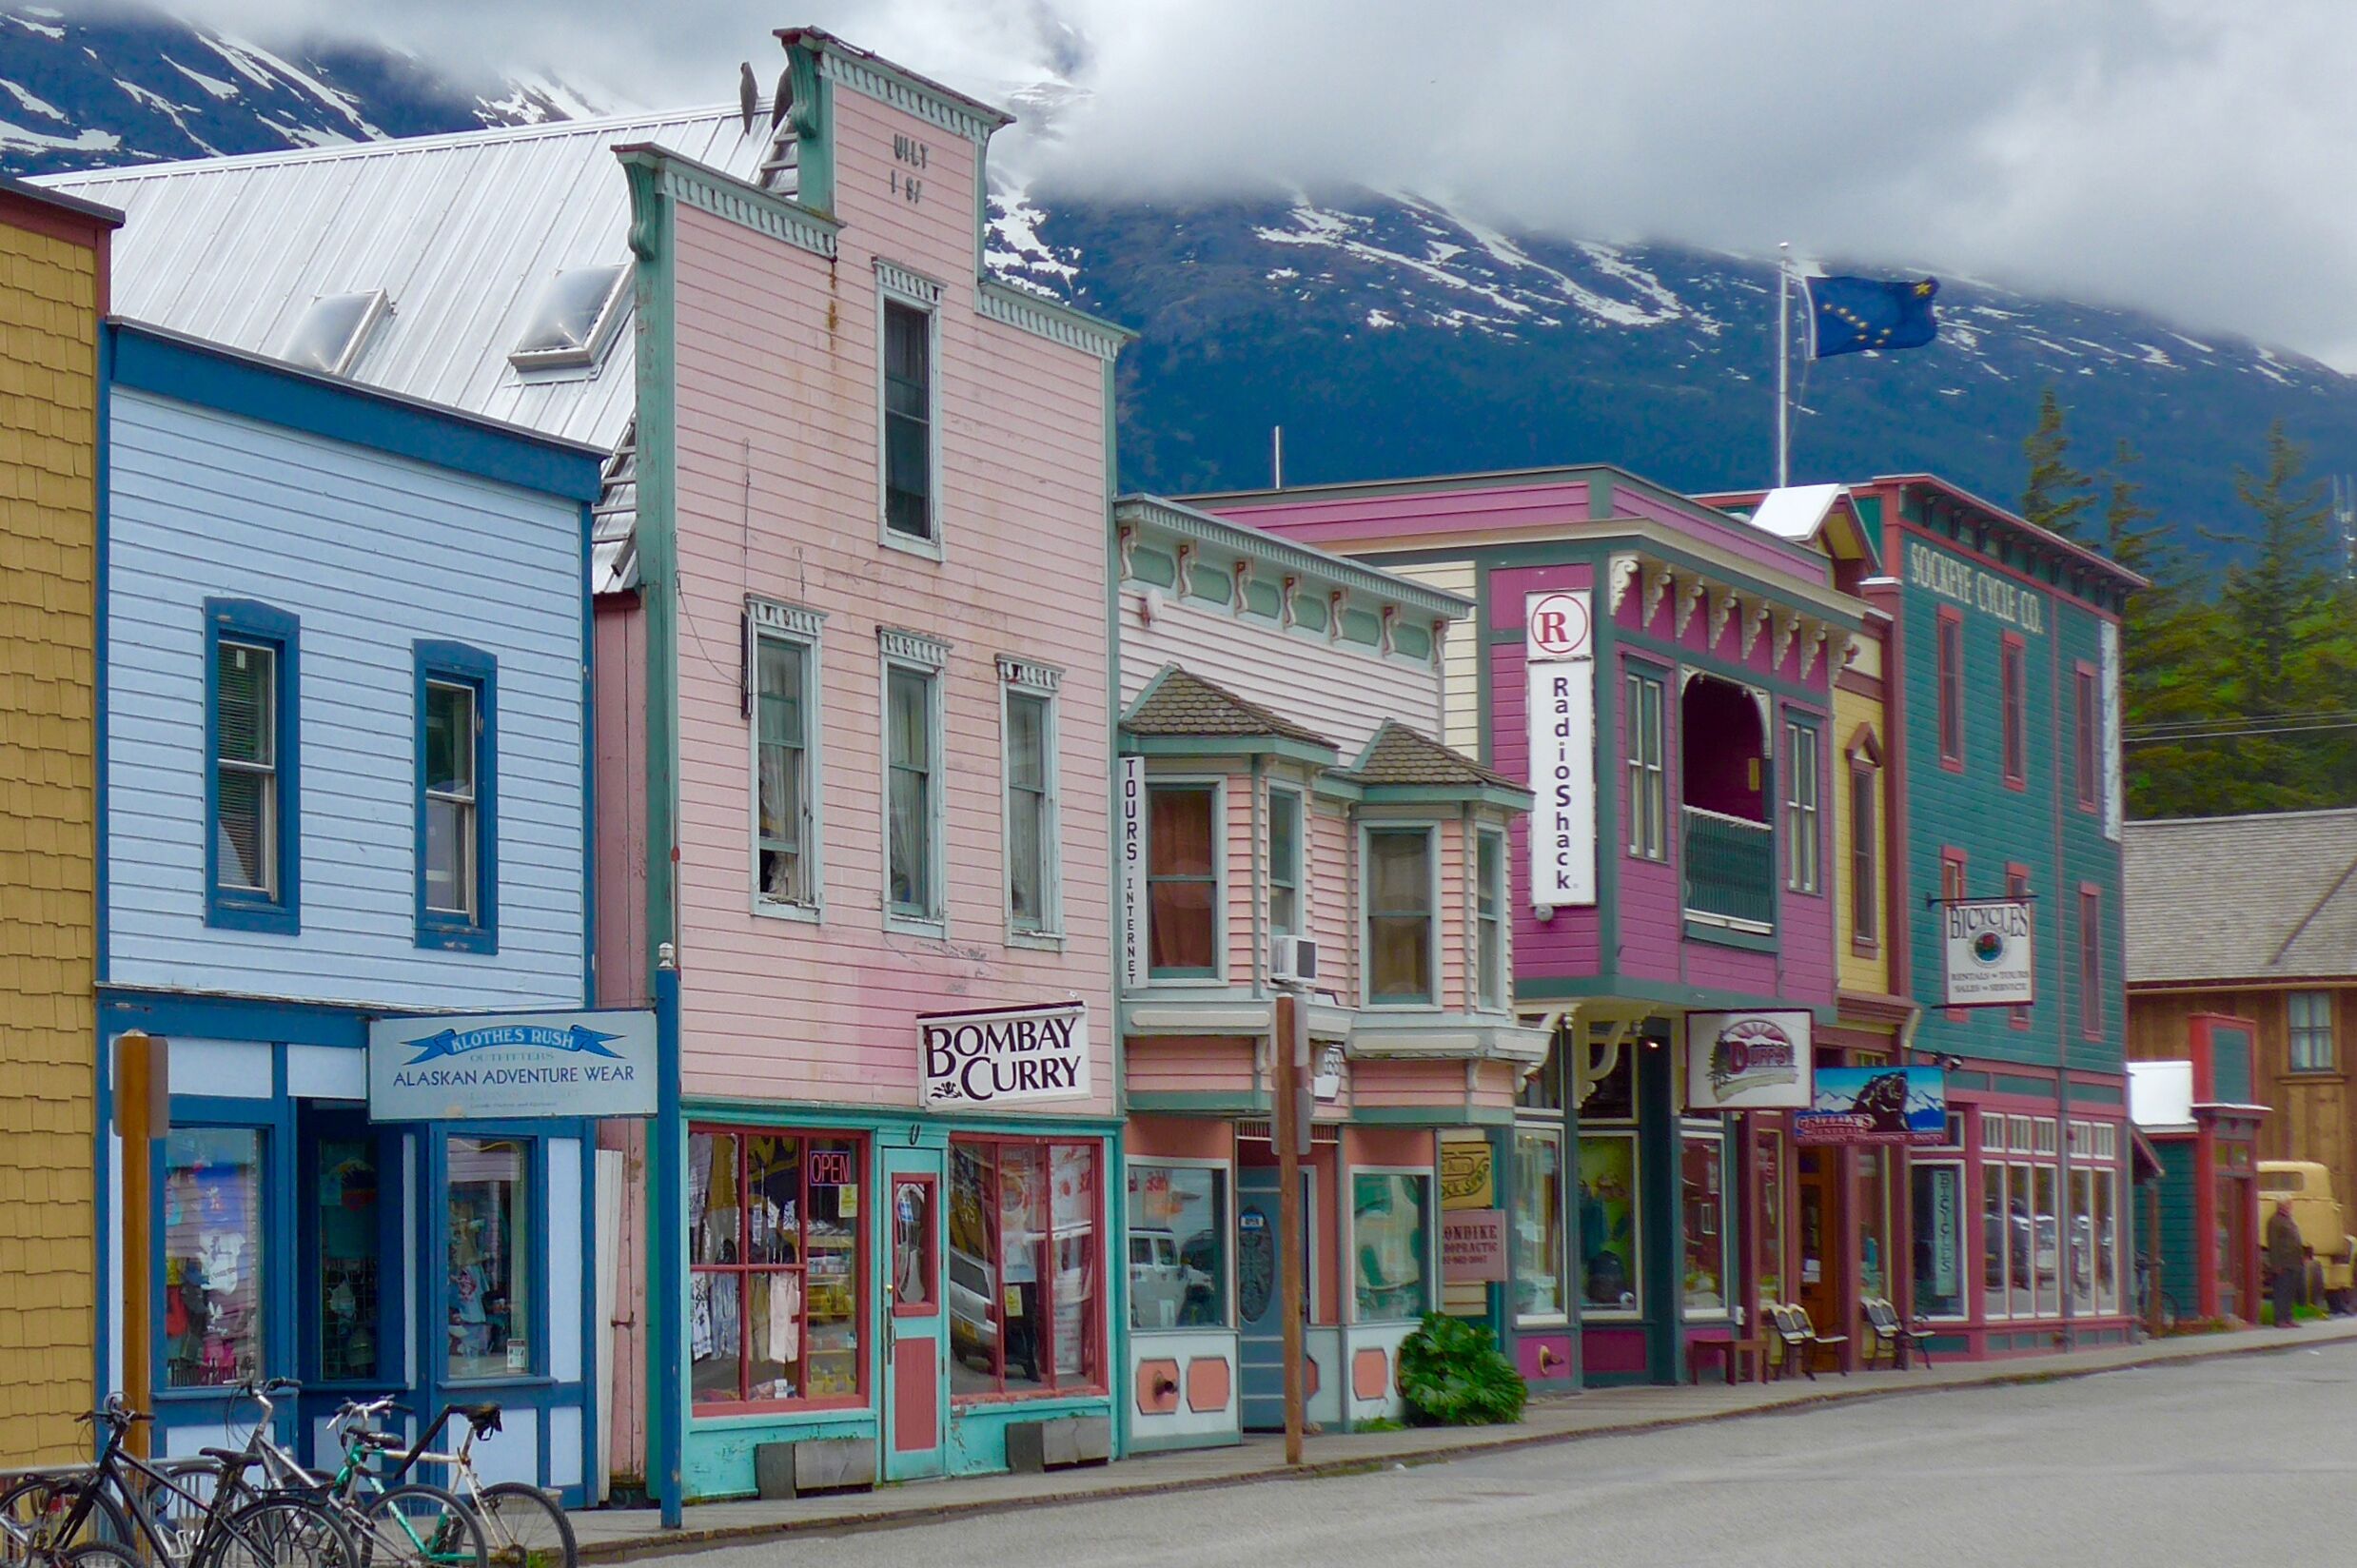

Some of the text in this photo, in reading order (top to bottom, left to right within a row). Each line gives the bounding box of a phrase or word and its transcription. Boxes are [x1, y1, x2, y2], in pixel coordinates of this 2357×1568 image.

[1912, 542, 1972, 604] SOCKEYE
[1978, 572, 2016, 622] CYCLE
[1538, 612, 1570, 644] R
[1553, 676, 1571, 890] RadioShack
[1125, 759, 1138, 986] TOURS INTERNET
[1950, 907, 2028, 938] BICYCLES
[451, 1028, 575, 1052] KLOTHES RUSH
[923, 1017, 1076, 1078] BOMBAY
[393, 1065, 635, 1088] ALASKAN ADVENTURE WEAR
[960, 1056, 1081, 1101] CURRY
[812, 1154, 851, 1183] OPEN
[1444, 1225, 1498, 1241] ONDIKE
